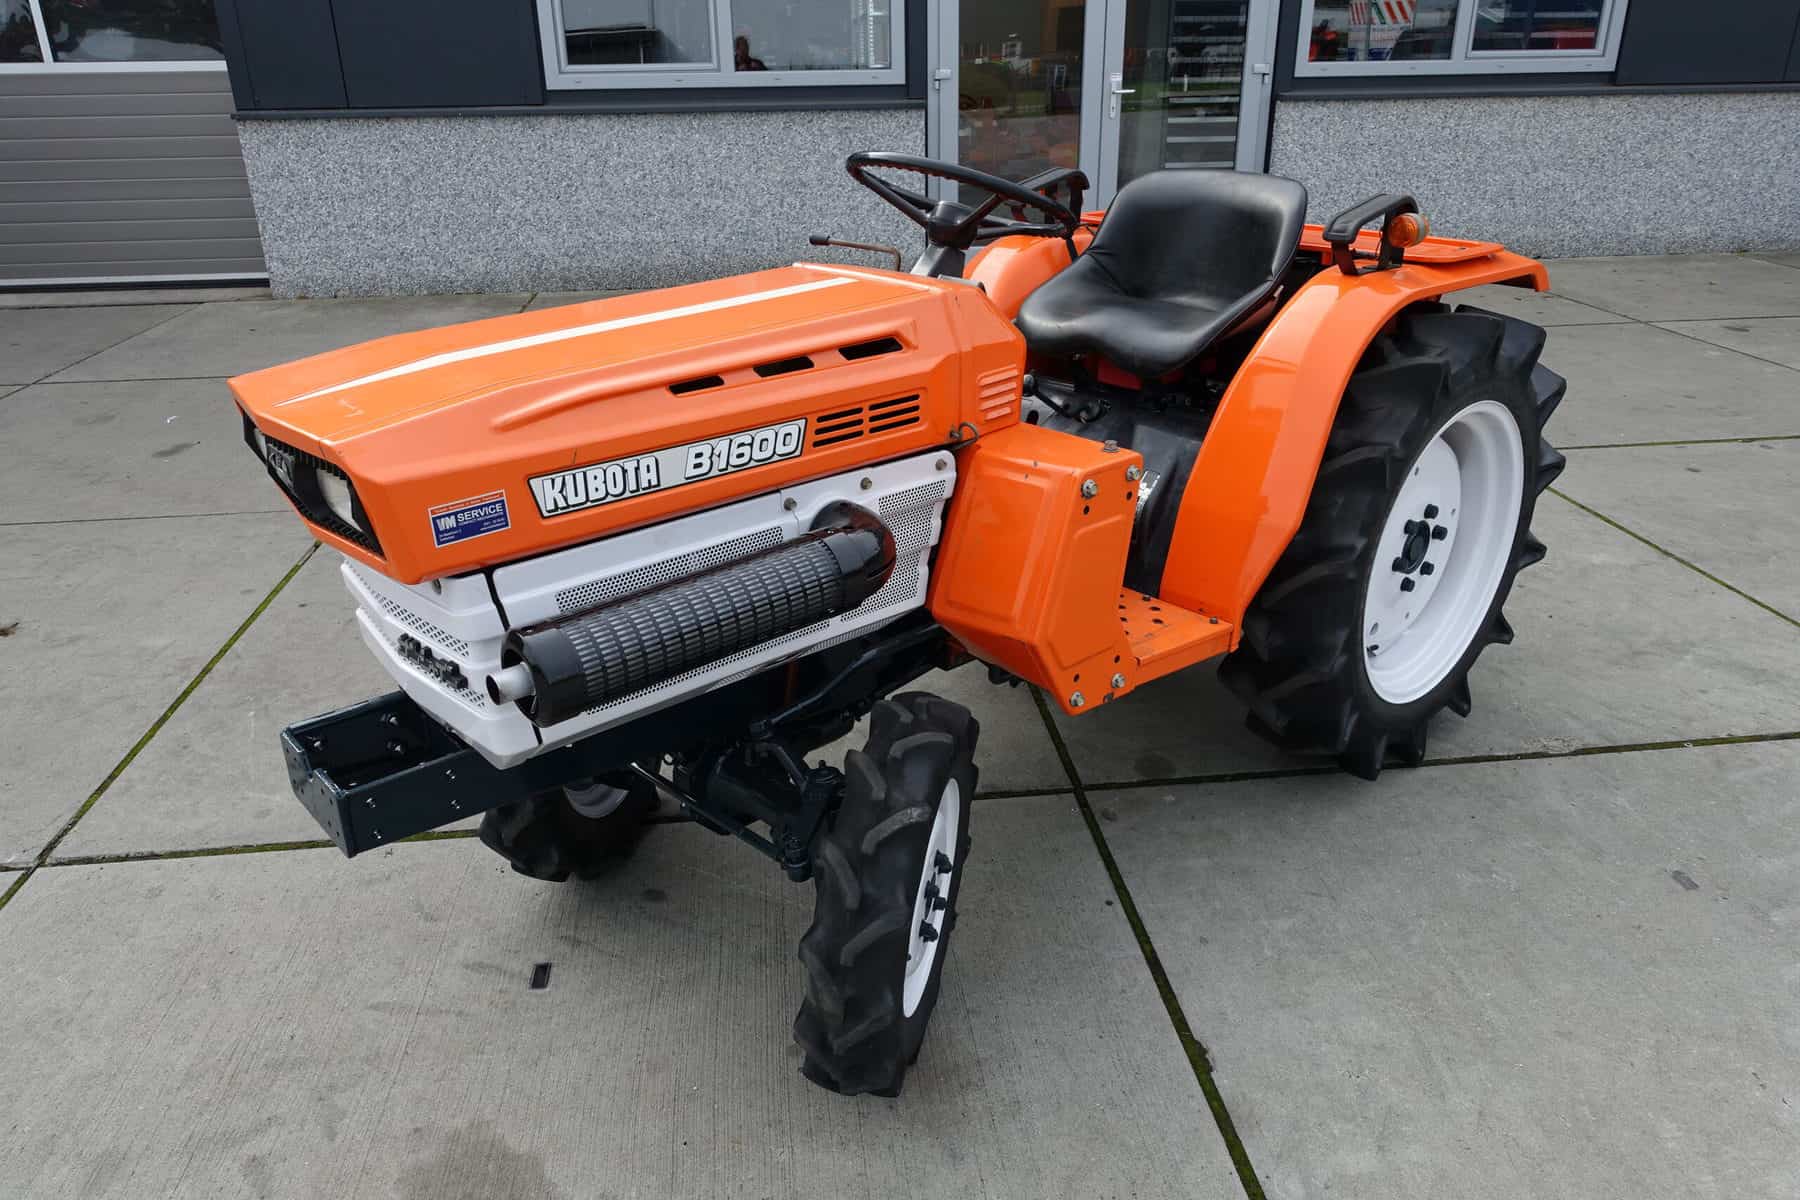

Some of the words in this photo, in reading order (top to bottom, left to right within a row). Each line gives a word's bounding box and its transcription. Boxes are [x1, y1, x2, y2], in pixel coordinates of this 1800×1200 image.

[542, 455, 660, 513] KUBOTA
[684, 423, 801, 479] B1600
[457, 503, 503, 522] SERVICE
